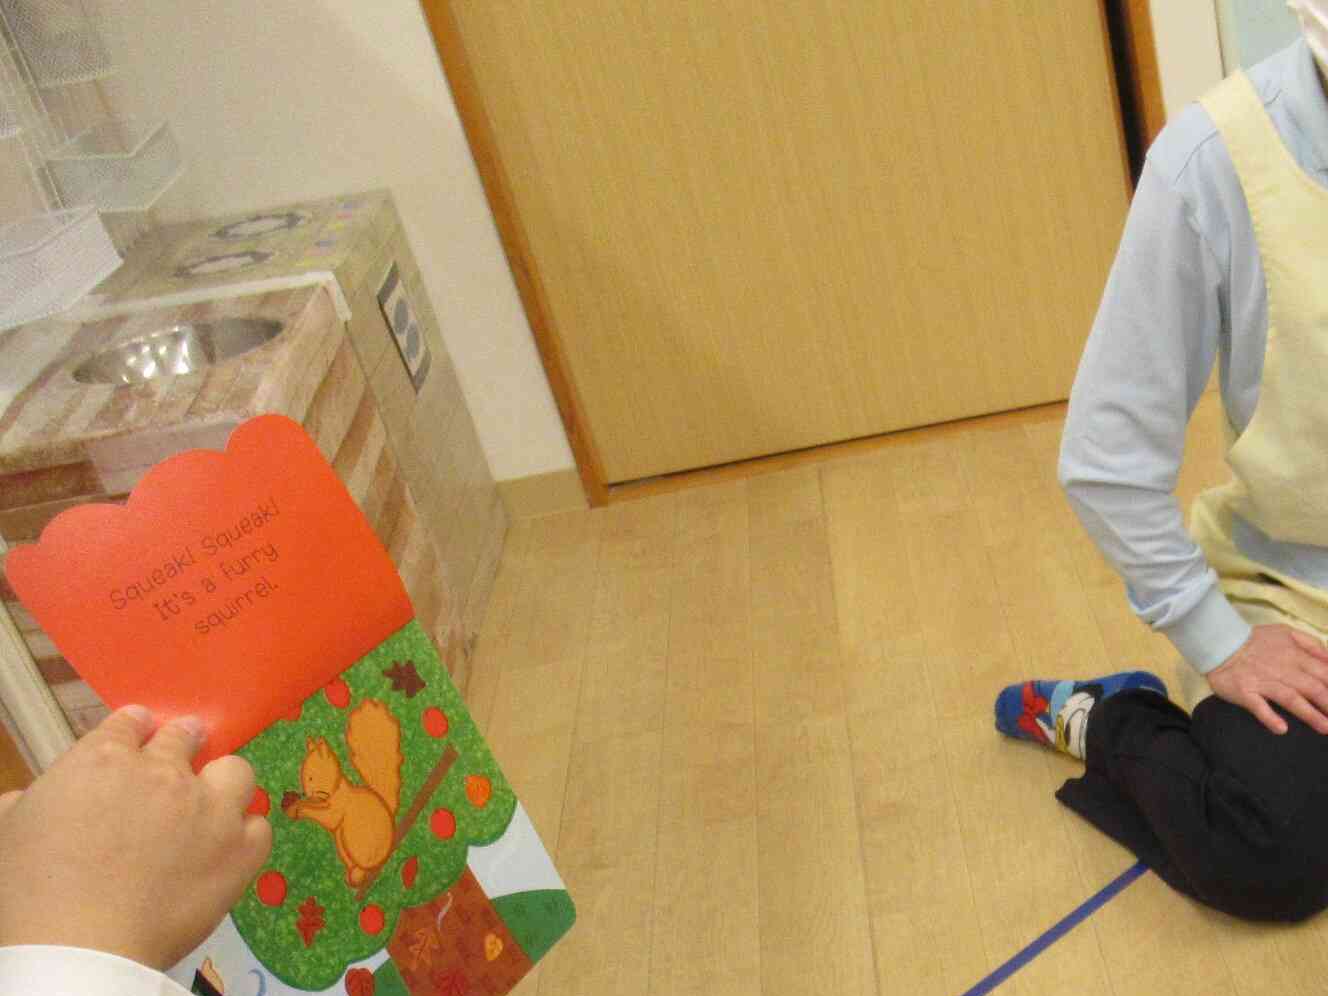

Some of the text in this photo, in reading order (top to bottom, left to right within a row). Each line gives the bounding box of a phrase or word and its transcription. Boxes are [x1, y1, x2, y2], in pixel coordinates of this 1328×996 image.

[109, 497, 280, 610] Squeak! Squeak!
[152, 543, 279, 621] It's a furry
[194, 575, 279, 634] squirrel.
